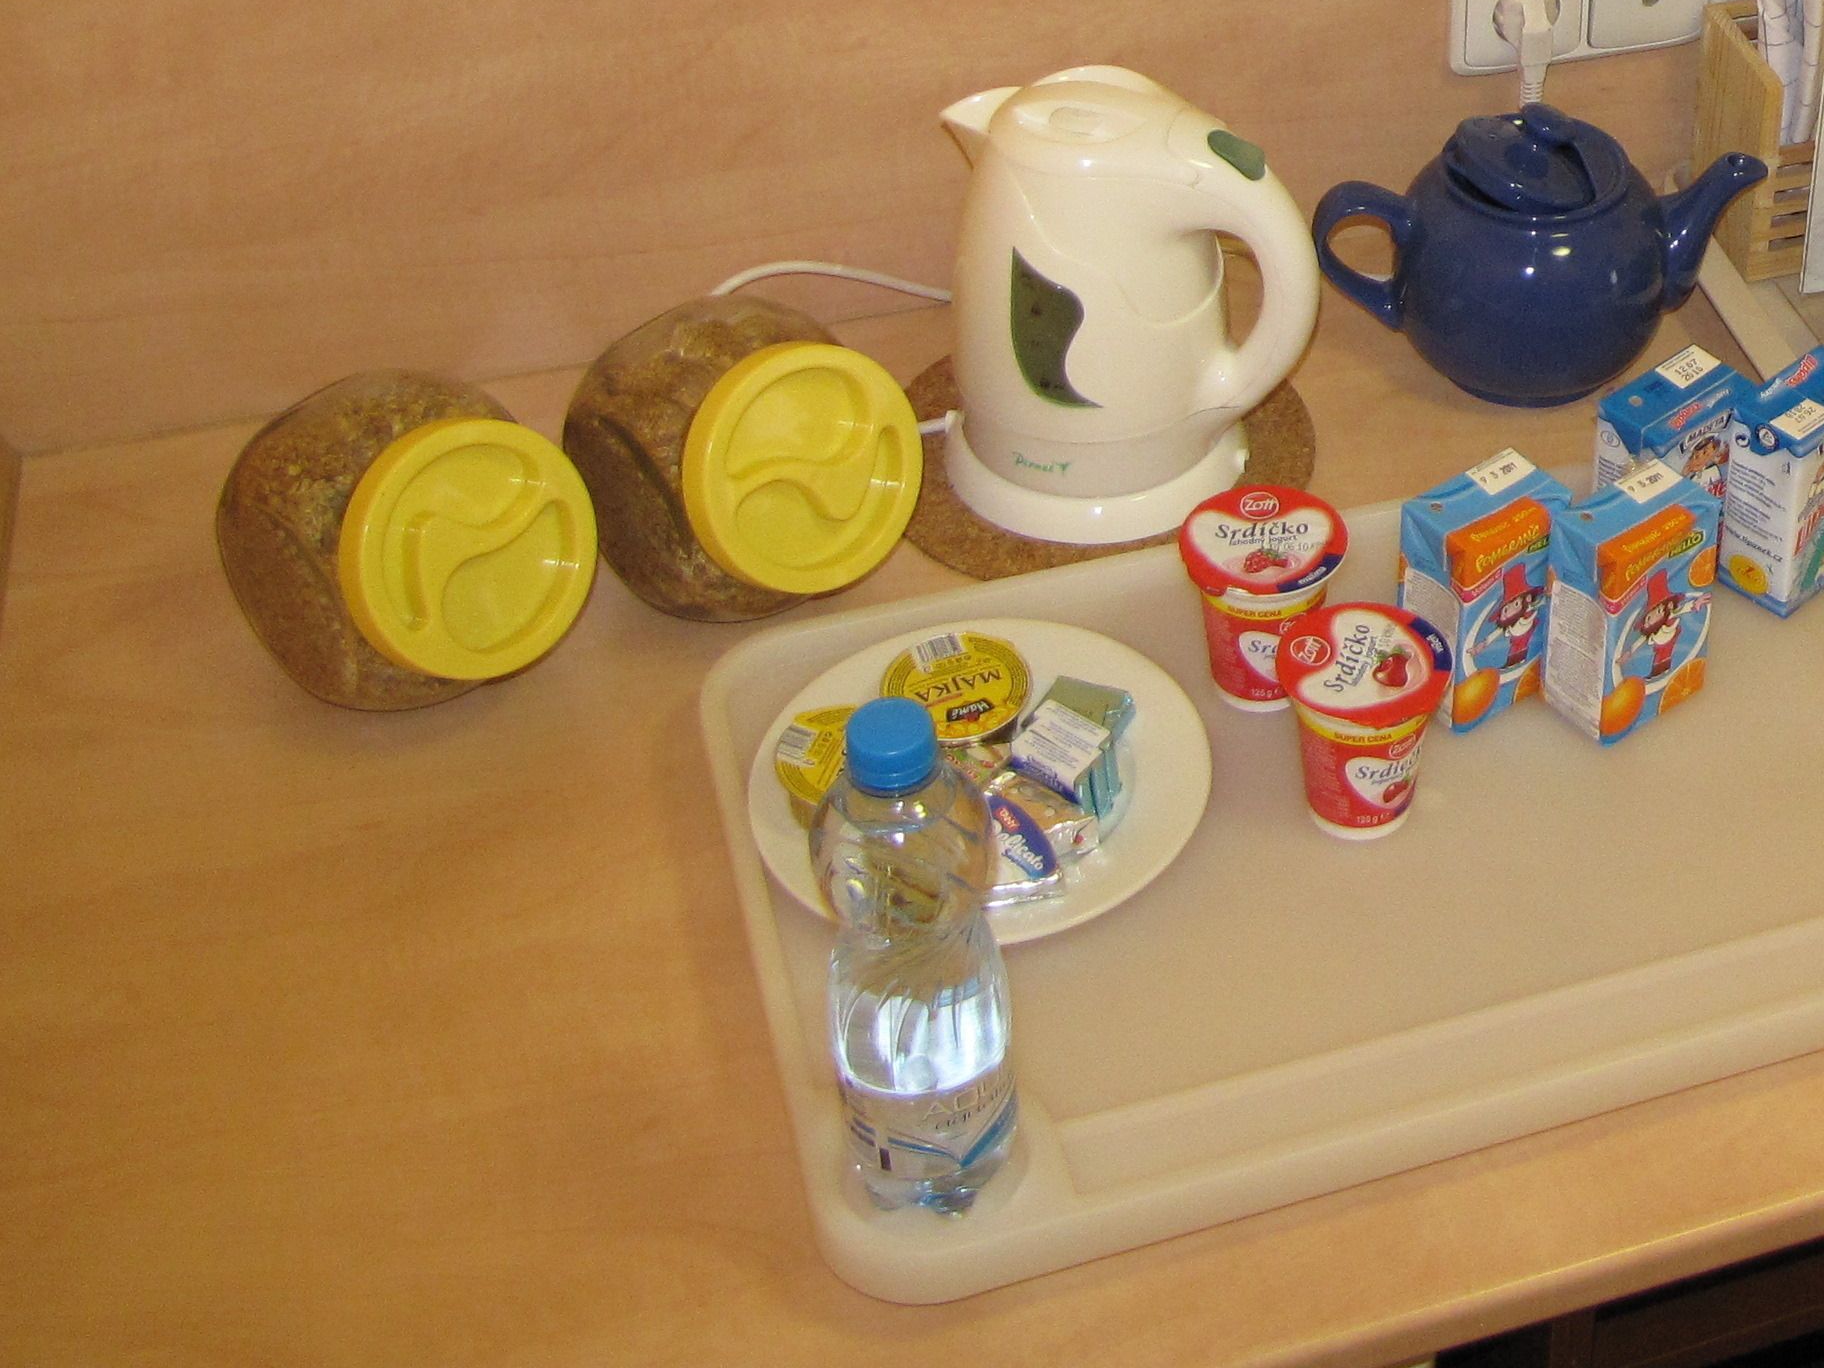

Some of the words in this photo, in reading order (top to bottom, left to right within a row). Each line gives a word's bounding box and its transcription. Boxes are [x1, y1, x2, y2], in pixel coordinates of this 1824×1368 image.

[1244, 498, 1277, 511] Zott
[1215, 521, 1309, 545] Srdíčko
[1228, 605, 1257, 617] SUPER
[1257, 609, 1282, 618] CENA
[1299, 636, 1322, 664] Zott
[1324, 624, 1370, 692] Srdíčko
[1334, 731, 1366, 743] SUPER
[1367, 733, 1392, 744] CENA
